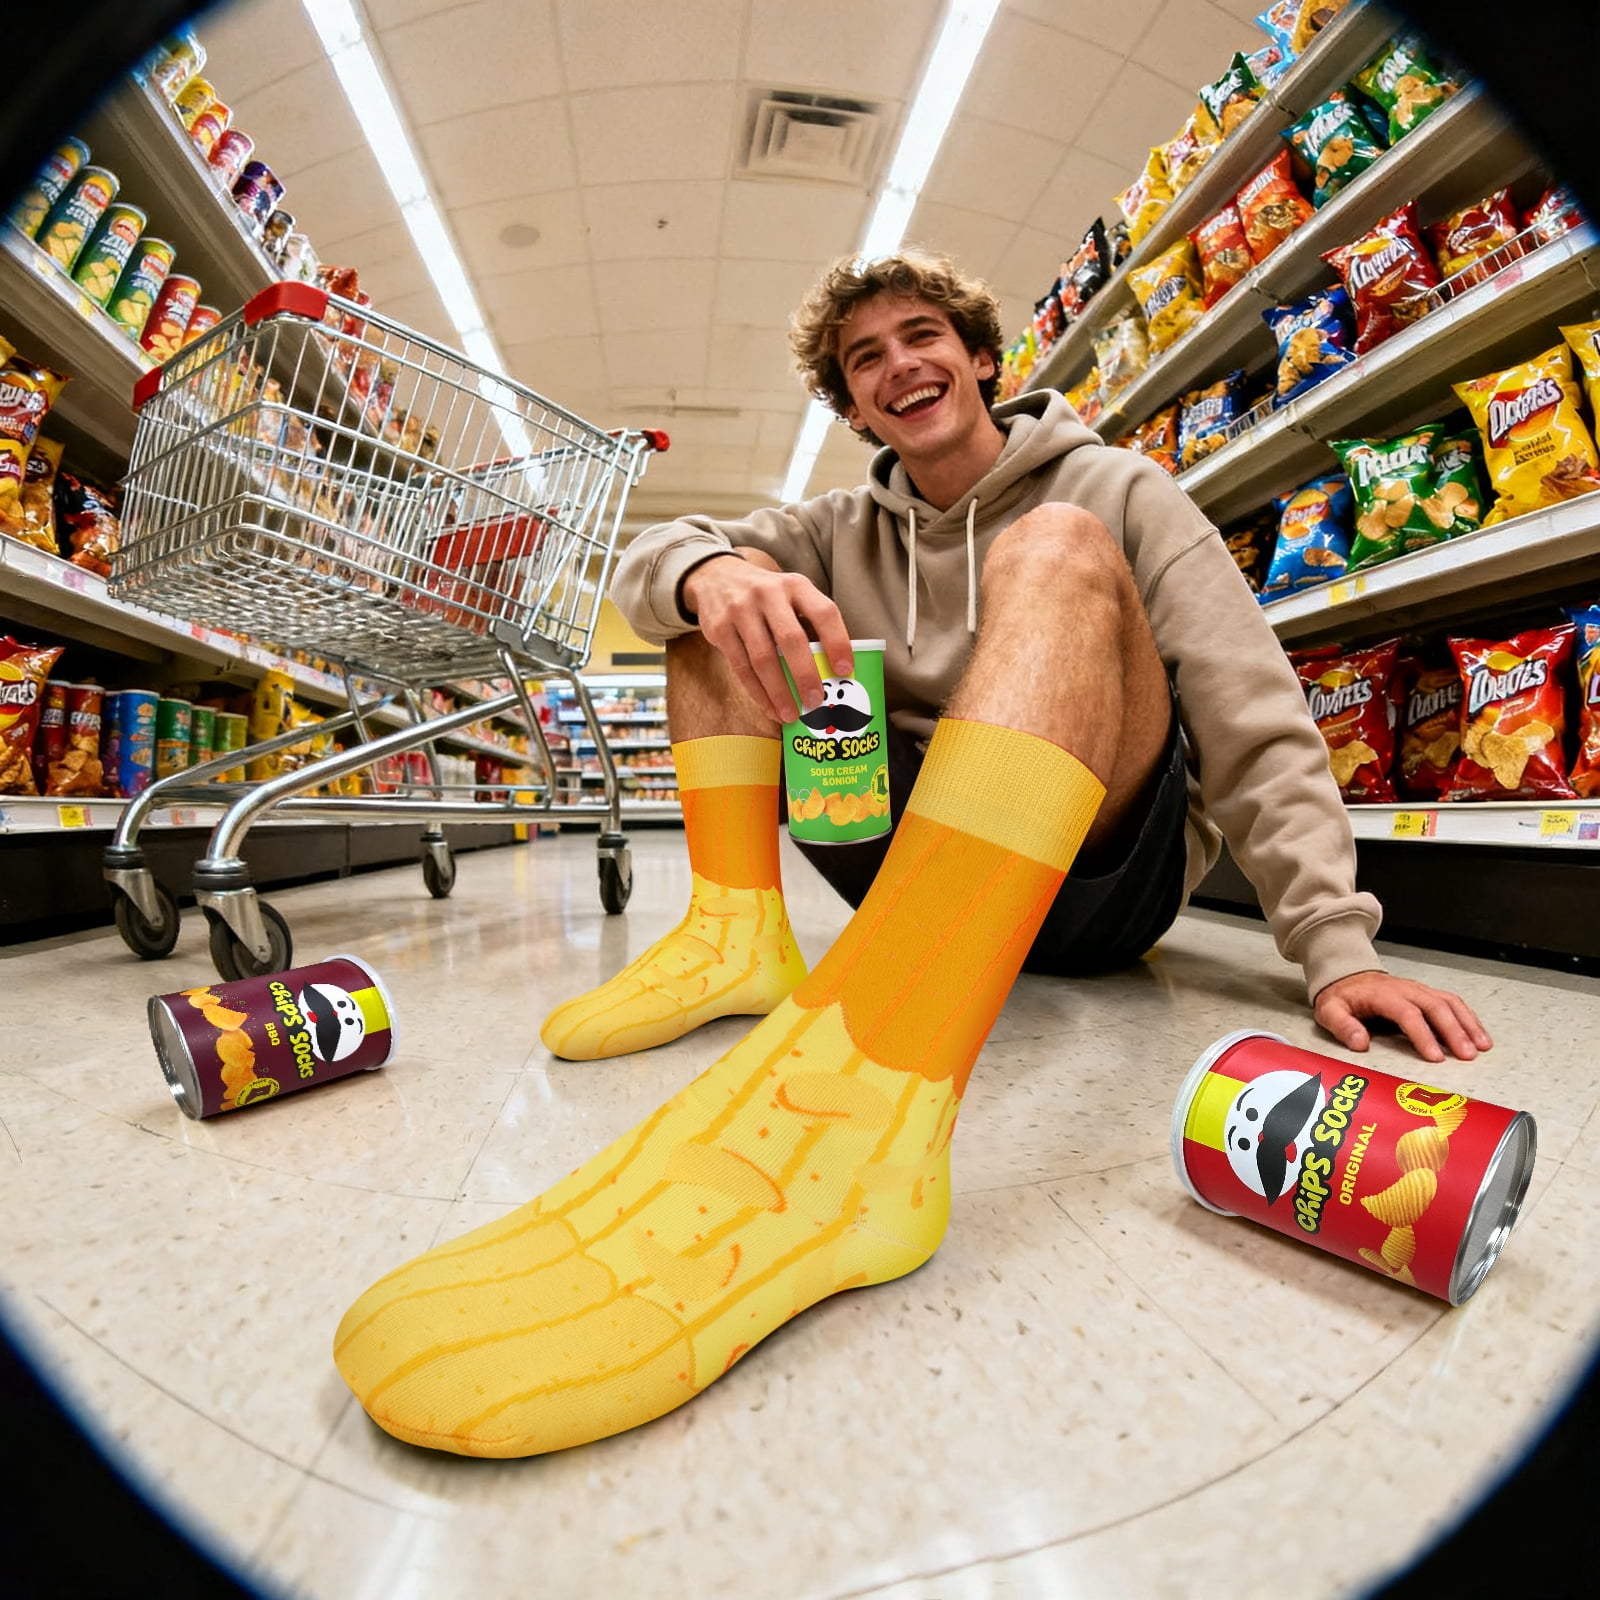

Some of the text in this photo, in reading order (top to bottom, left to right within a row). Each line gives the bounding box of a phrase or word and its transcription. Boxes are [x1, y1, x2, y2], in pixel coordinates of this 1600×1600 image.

[810, 764, 868, 777] SOUR CREAM
[822, 775, 858, 787] &ONION
[1338, 1122, 1378, 1206] ORIGINAL
